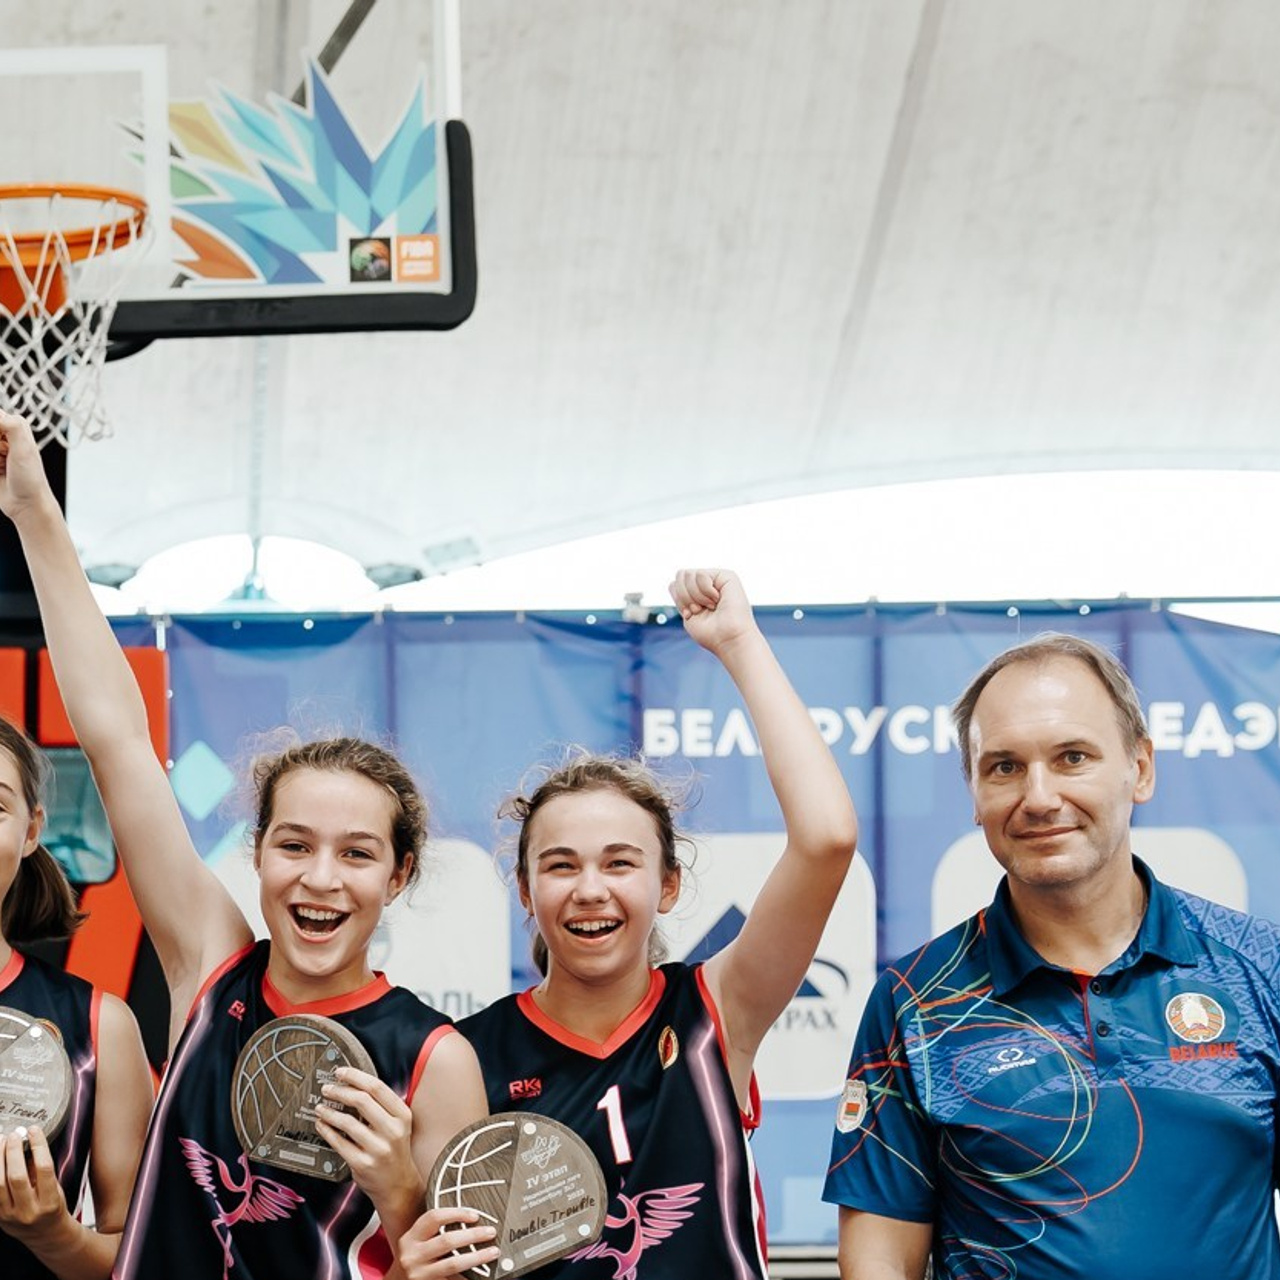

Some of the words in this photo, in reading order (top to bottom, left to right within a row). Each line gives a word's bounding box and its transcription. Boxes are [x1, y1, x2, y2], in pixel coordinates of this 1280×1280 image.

[1169, 1042, 1239, 1063] BELARUS
[596, 1084, 633, 1165] 1
[509, 1216, 548, 1243] Double
